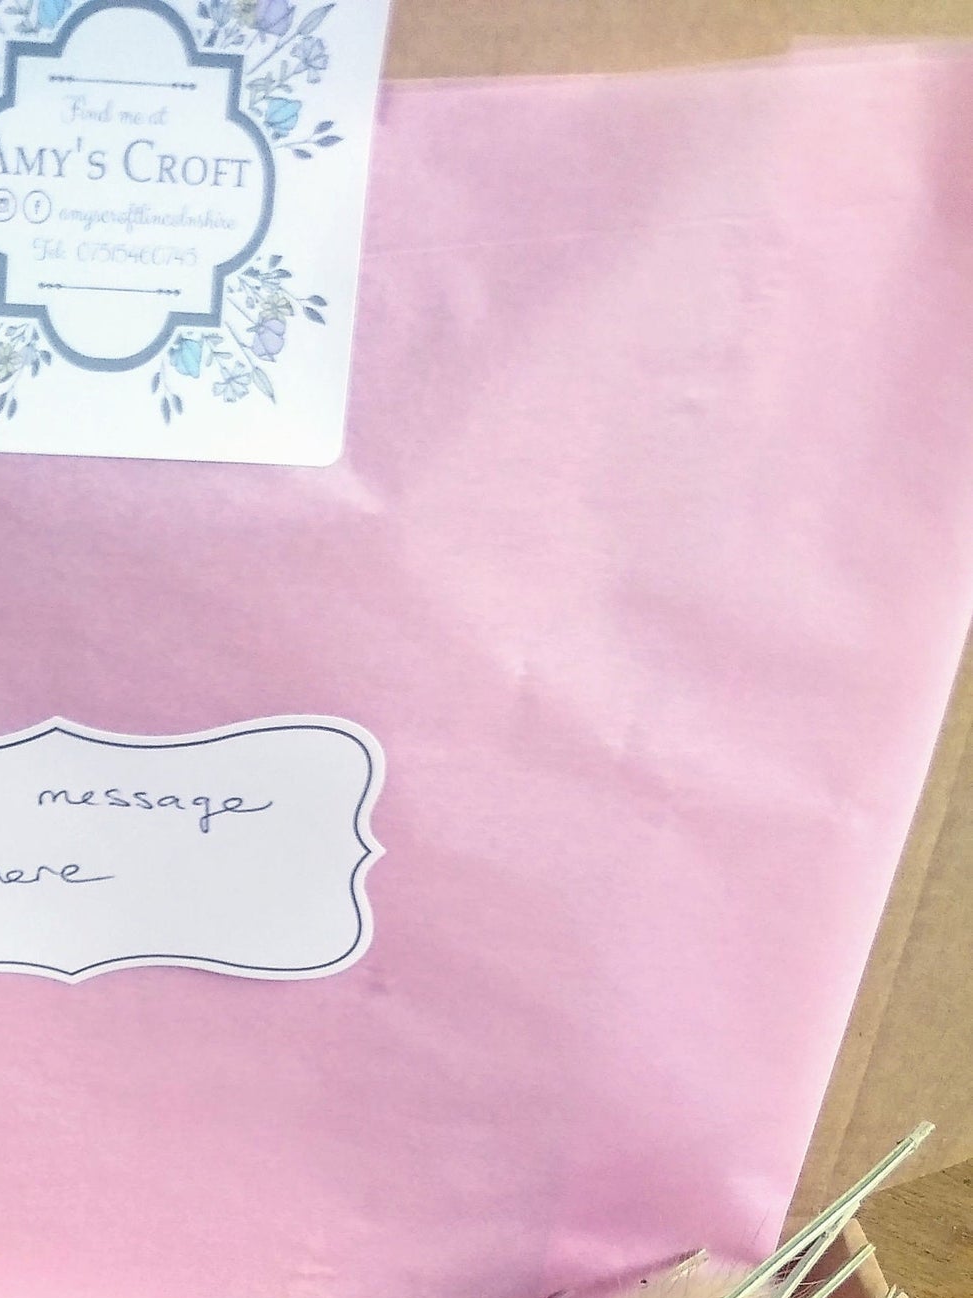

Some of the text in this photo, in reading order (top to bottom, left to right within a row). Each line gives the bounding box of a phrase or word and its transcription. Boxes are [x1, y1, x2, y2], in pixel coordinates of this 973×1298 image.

[61, 94, 170, 125] Find me at
[124, 139, 251, 187] CROFT
[58, 203, 236, 233] amyscroftlincolnshire
[37, 786, 275, 834] message
